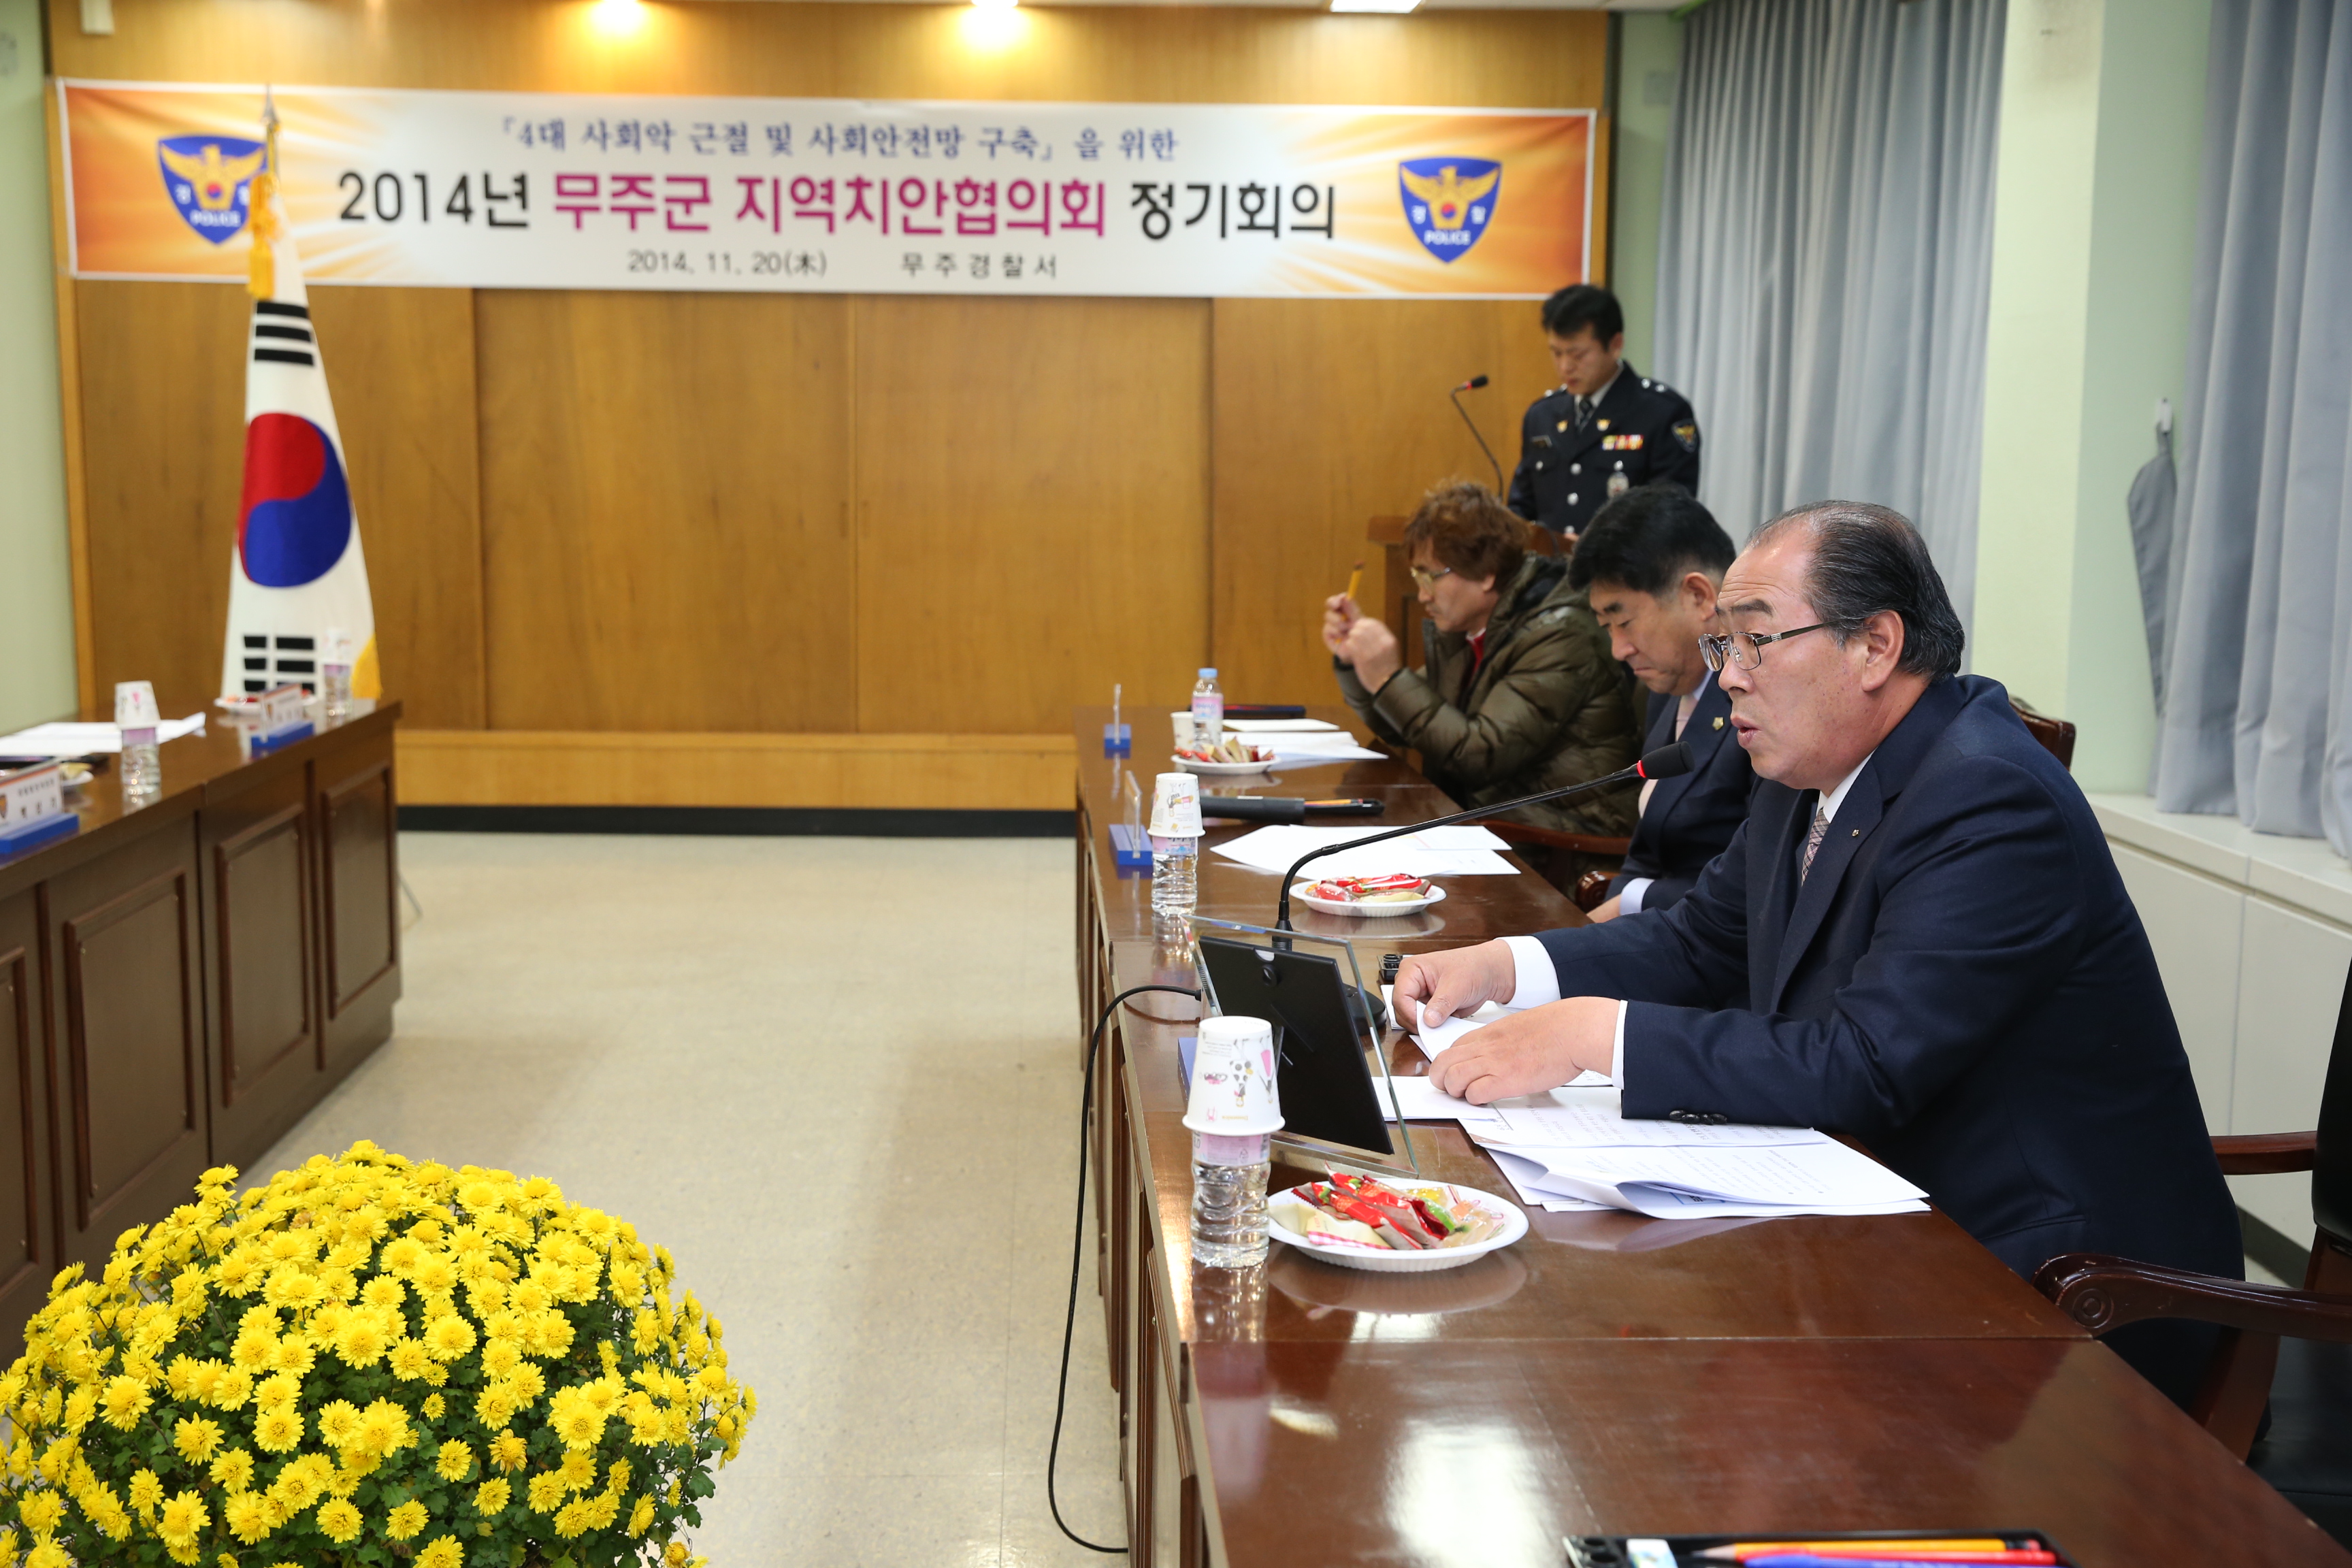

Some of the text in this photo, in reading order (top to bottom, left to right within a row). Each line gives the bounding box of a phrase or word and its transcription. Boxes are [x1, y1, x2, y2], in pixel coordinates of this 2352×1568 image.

[583, 118, 674, 152] 사회악
[689, 120, 749, 155] 근절
[808, 122, 963, 158] 사회안전망
[1074, 127, 1102, 160] 을
[1117, 127, 1177, 161] 위한
[337, 170, 1336, 242] 2014년 무주군 지역치안협의회 정기회의
[1424, 229, 1471, 246] POLICE
